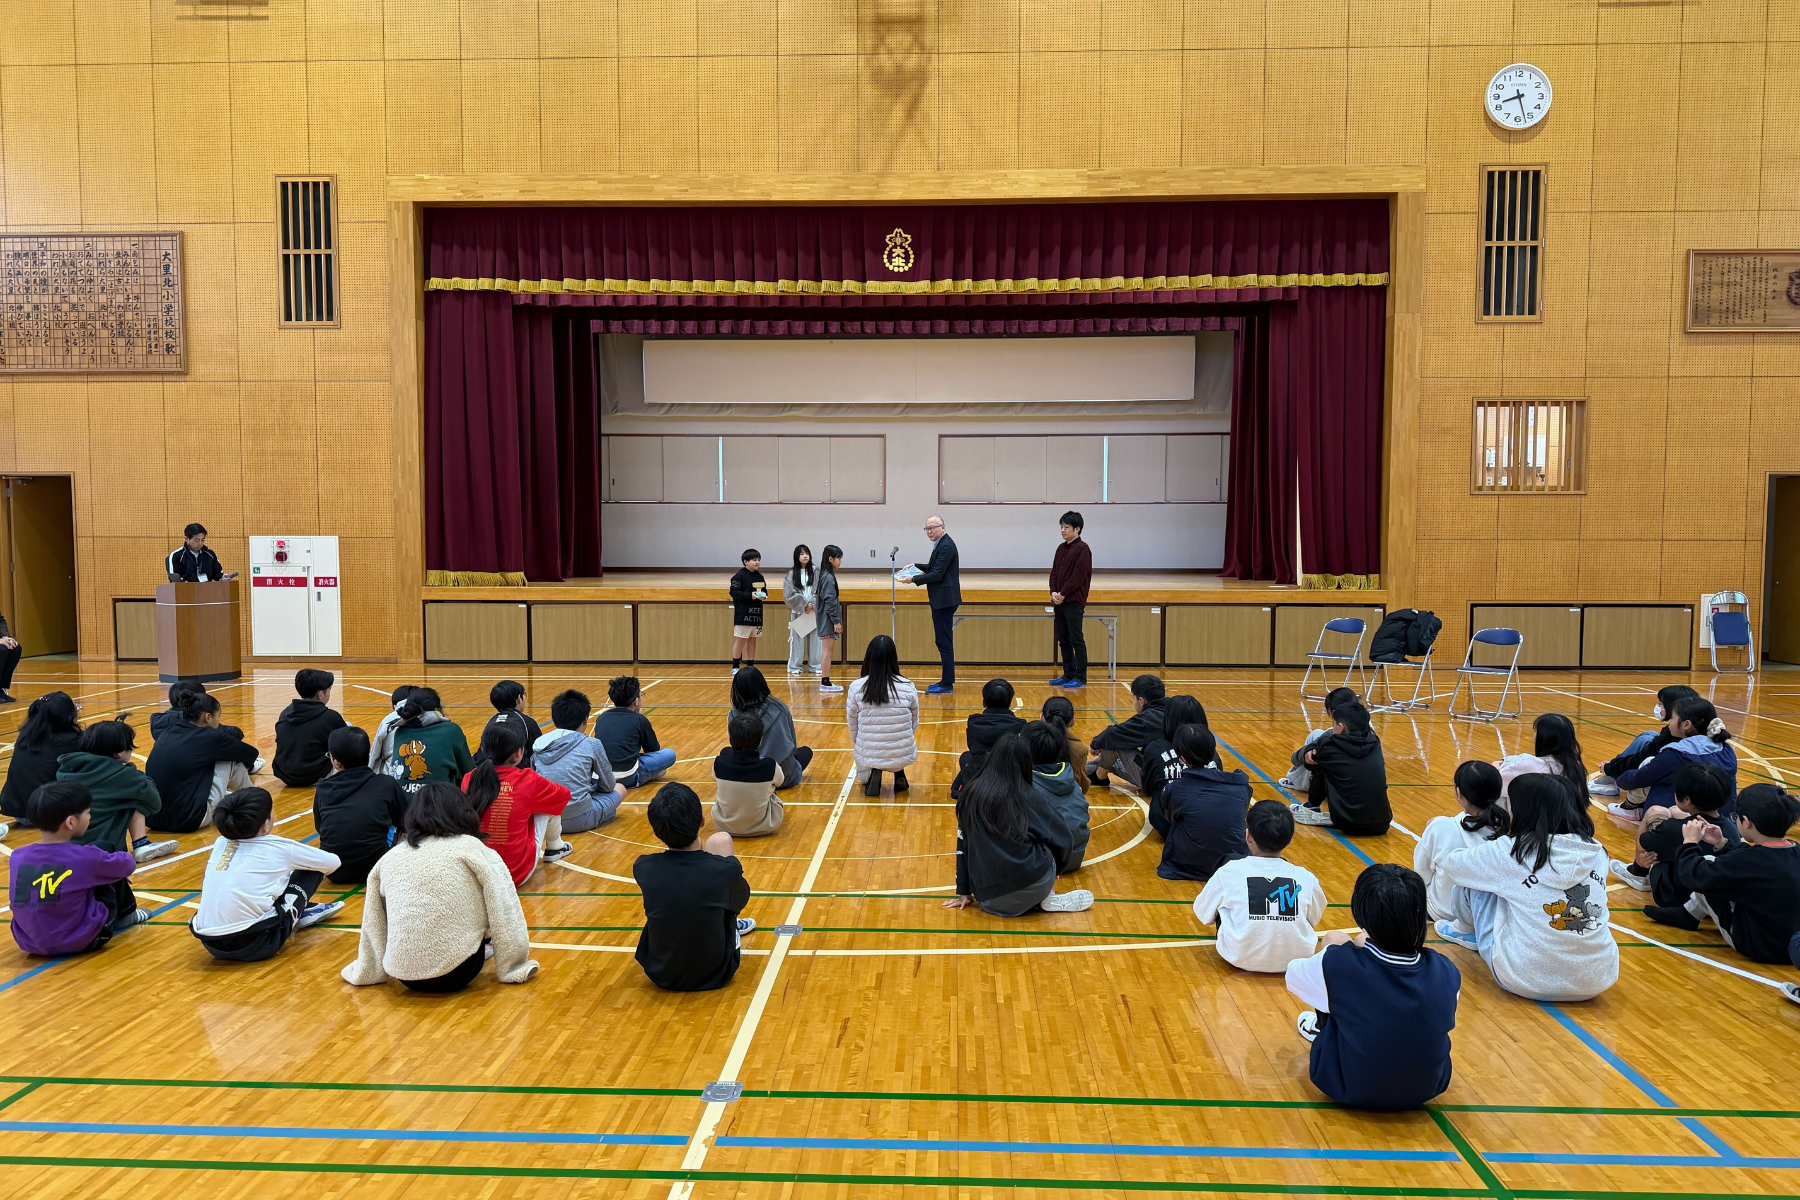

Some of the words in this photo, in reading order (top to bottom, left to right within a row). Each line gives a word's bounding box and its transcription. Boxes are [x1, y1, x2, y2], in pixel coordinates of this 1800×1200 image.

[162, 251, 176, 354] 大里北小学校校歌
[1247, 876, 1302, 915] MTV
[1522, 874, 1539, 889] TO
